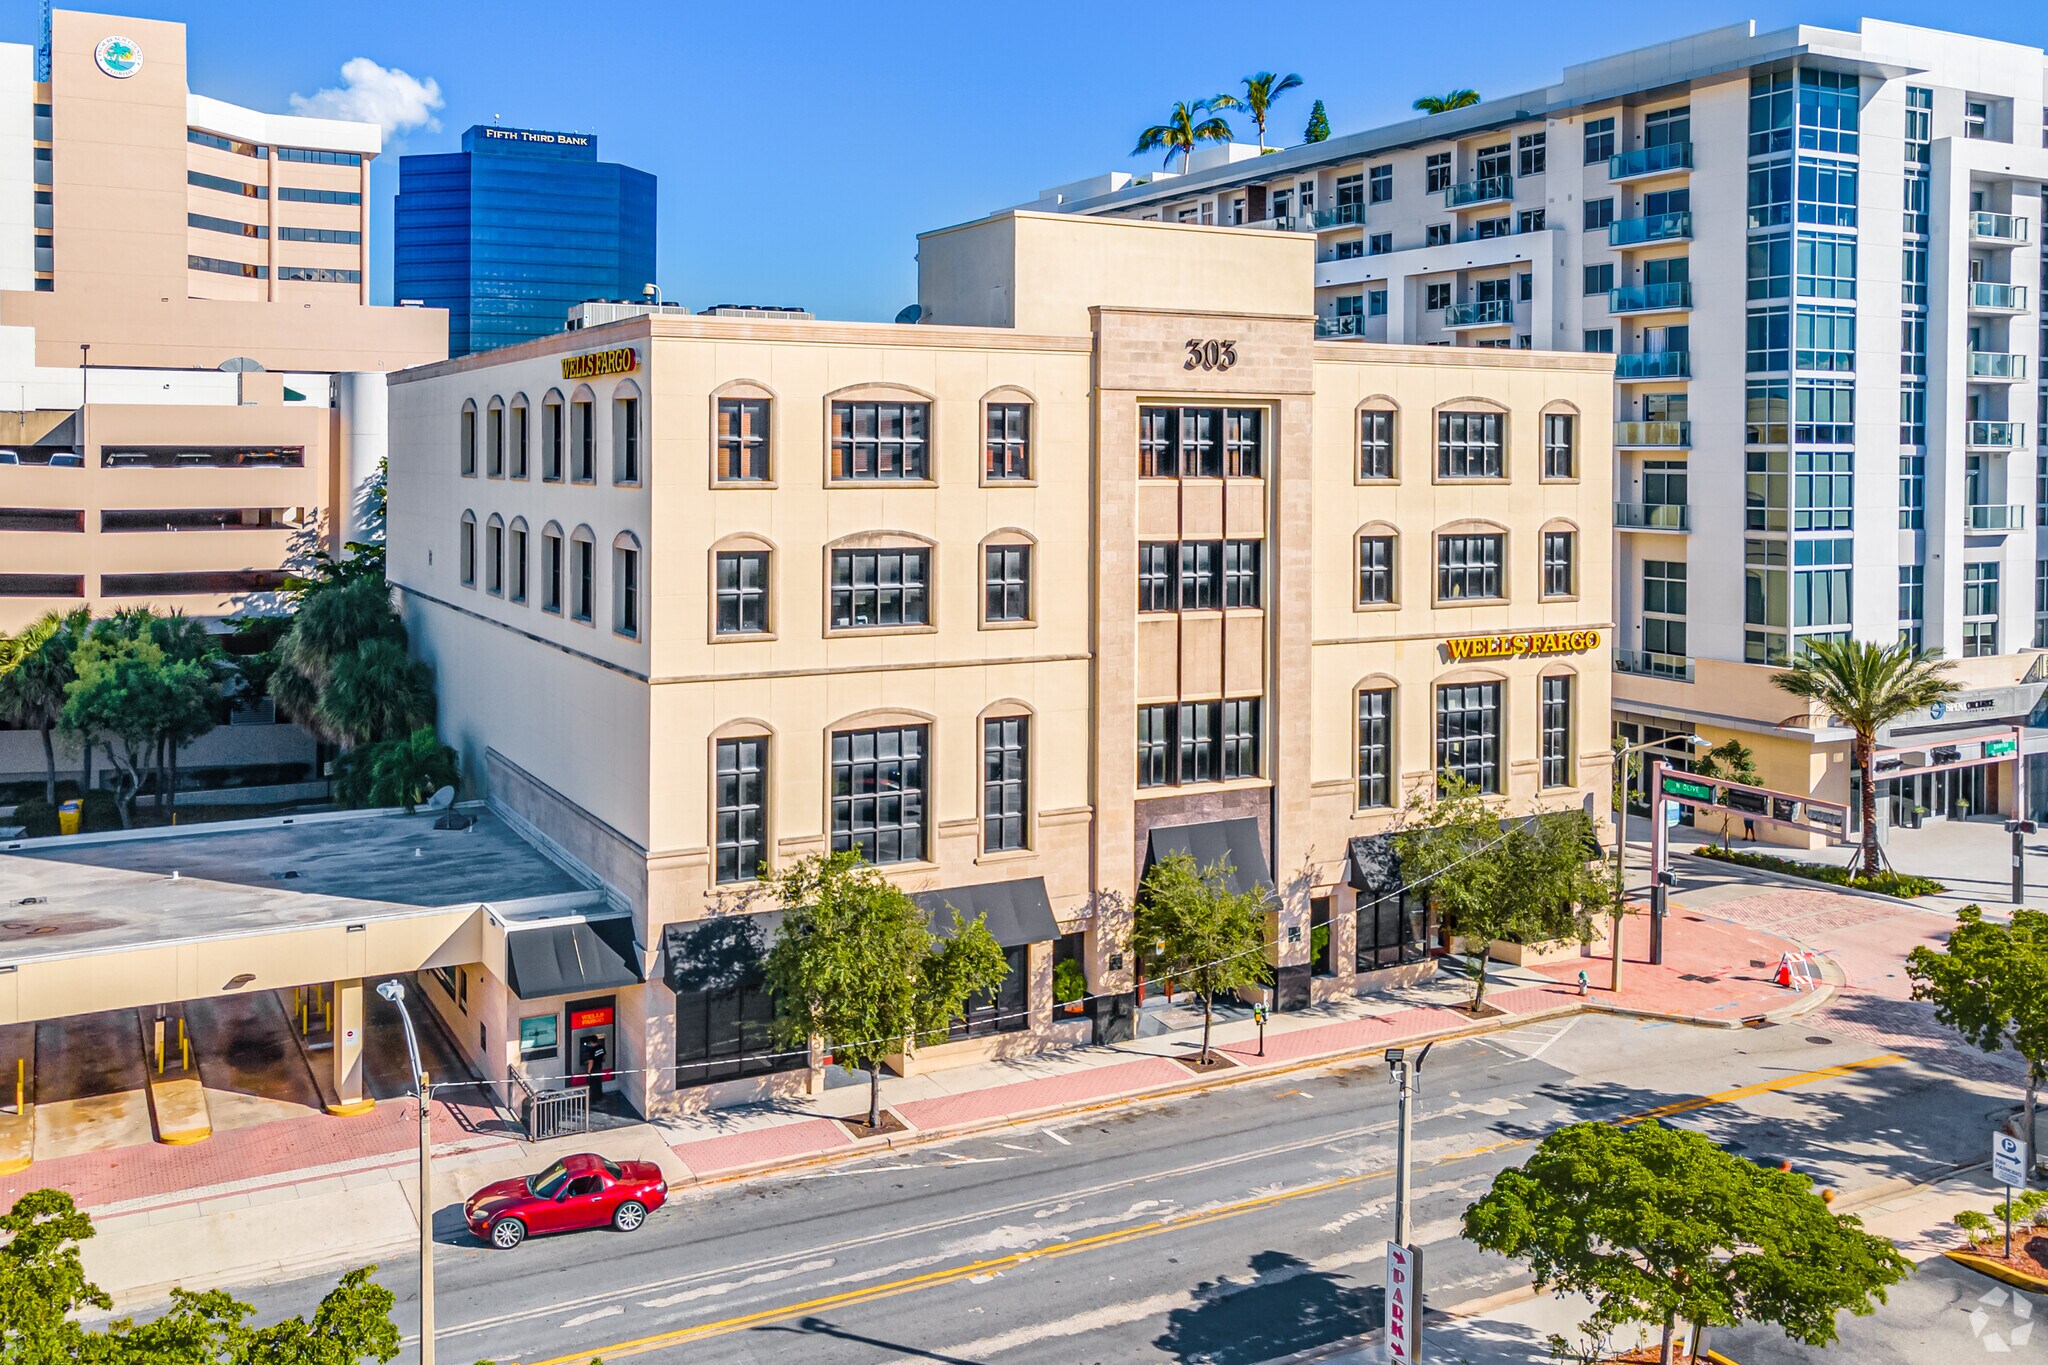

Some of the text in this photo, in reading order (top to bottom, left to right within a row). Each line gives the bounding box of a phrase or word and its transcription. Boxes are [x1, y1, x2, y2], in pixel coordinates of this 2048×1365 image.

[557, 135, 588, 146] BANK
[1184, 339, 1238, 371] 303
[561, 347, 634, 379] WELLS FARGO
[1448, 631, 1600, 658] WELLS FARGO
[1682, 783, 1700, 794] OLIVE
[581, 1012, 605, 1020] WELLS
[581, 1017, 605, 1026] FARGO
[1995, 1158, 2006, 1166] PAY
[1995, 1163, 2022, 1178] PARKING
[1391, 1267, 1405, 1341] PARK
